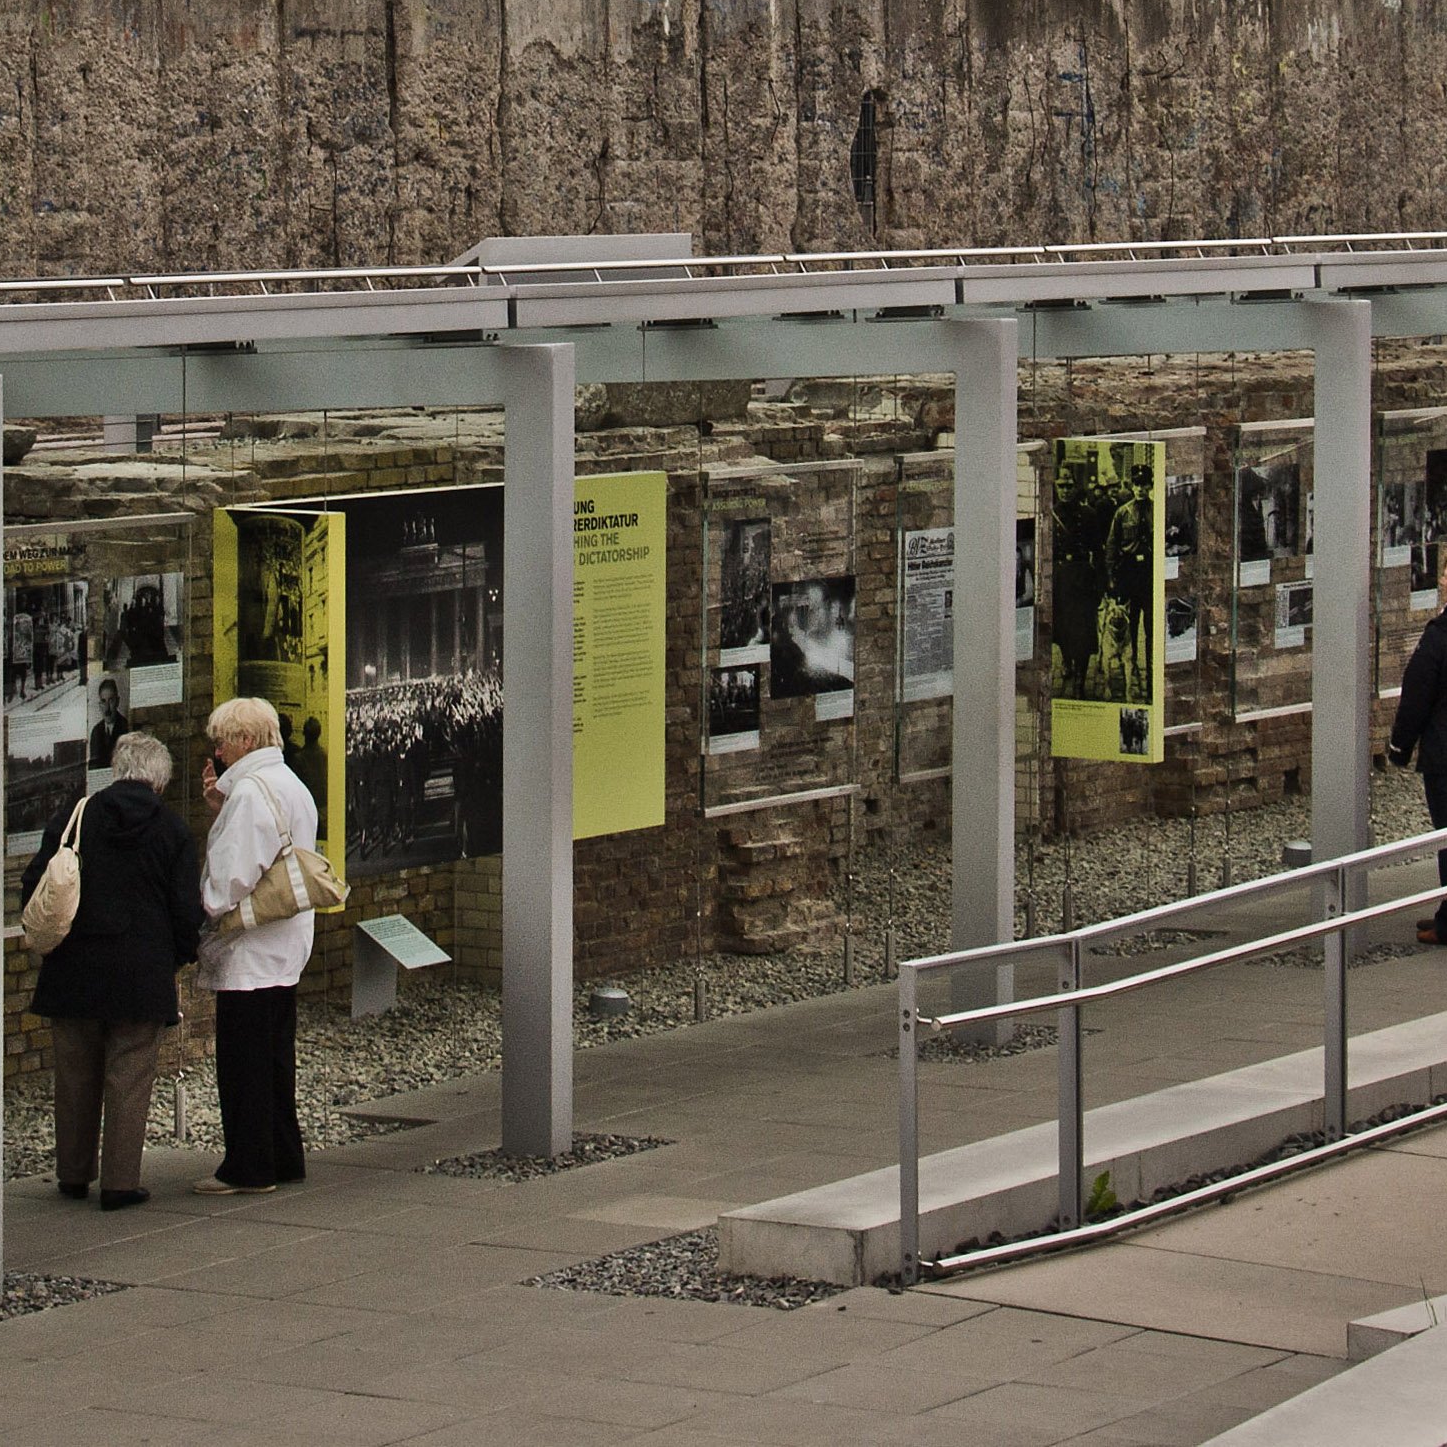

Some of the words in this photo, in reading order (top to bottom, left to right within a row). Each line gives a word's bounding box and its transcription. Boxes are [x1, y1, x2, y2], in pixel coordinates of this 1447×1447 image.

[573, 500, 595, 514] UNG
[573, 513, 638, 532] RERDIKTATUR
[573, 534, 598, 549] HING
[600, 532, 620, 547] THE
[3, 550, 17, 562] EM
[19, 549, 39, 560] WEG
[39, 547, 58, 558] ZUR
[579, 545, 650, 566] DICTATORSHIP
[3, 562, 22, 574] OAD
[23, 562, 34, 573] TO
[36, 559, 67, 572] POWER
